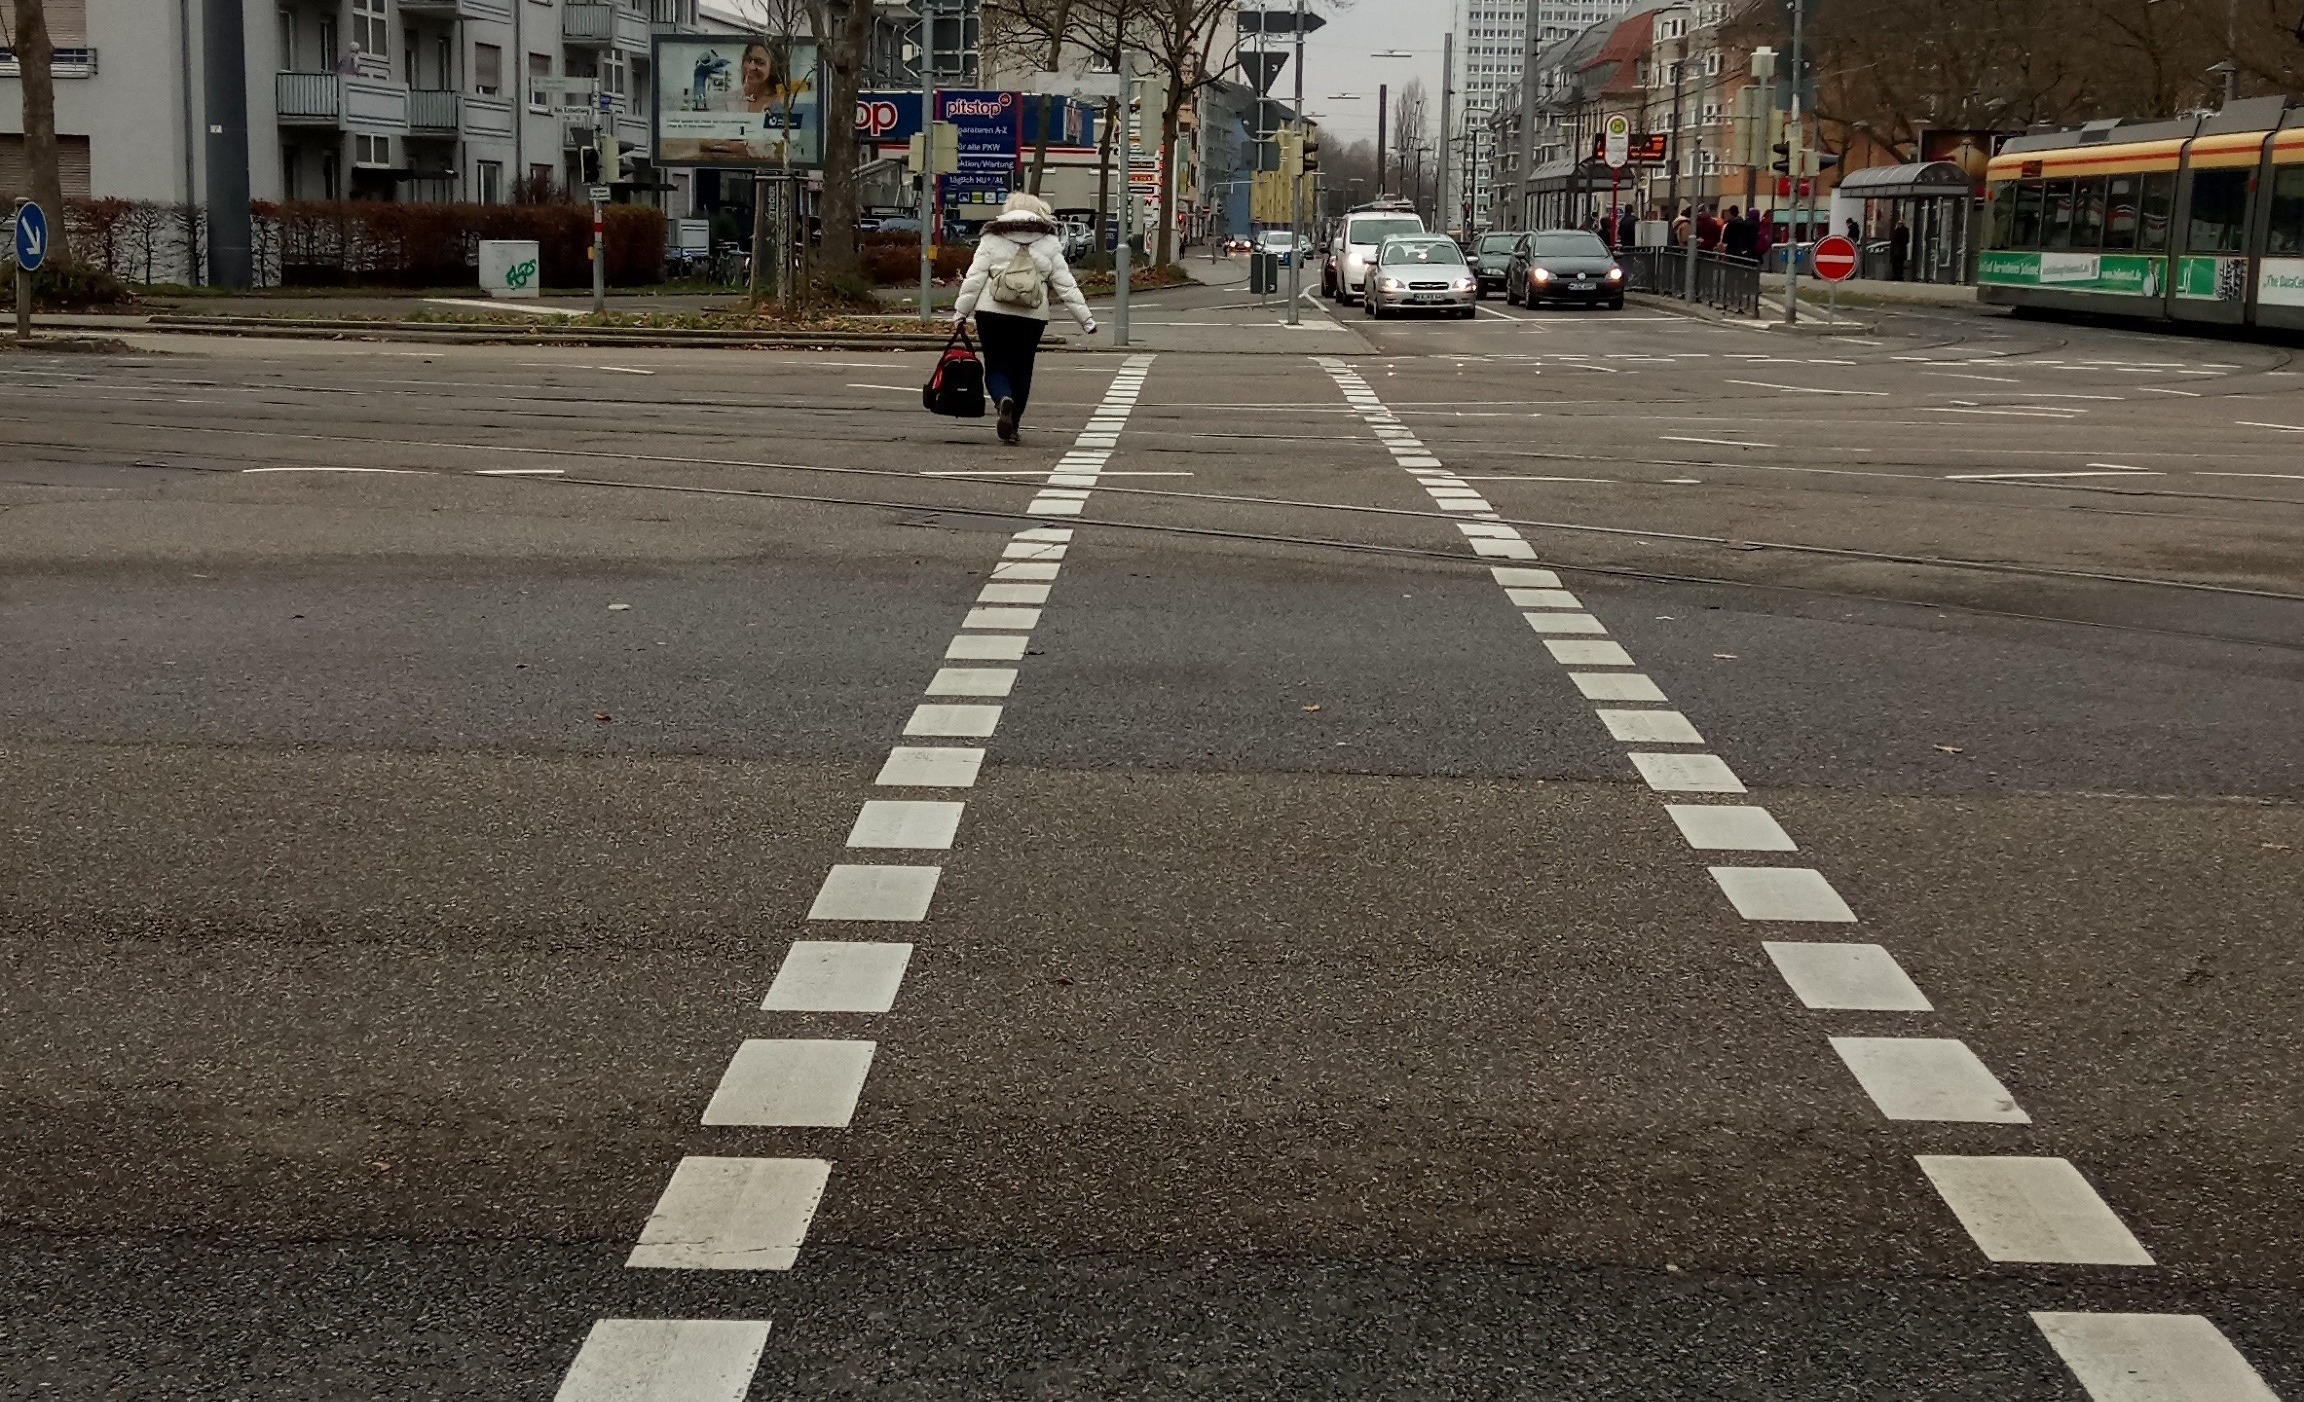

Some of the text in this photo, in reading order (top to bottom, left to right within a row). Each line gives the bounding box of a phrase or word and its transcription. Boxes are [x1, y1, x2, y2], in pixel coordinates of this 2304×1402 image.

[946, 98, 1001, 119] pitstop
[855, 100, 898, 137] op
[957, 126, 994, 137] paraturen
[957, 143, 966, 151] ür
[982, 143, 1000, 151] PKW
[957, 160, 1015, 170] ktion/Wartung
